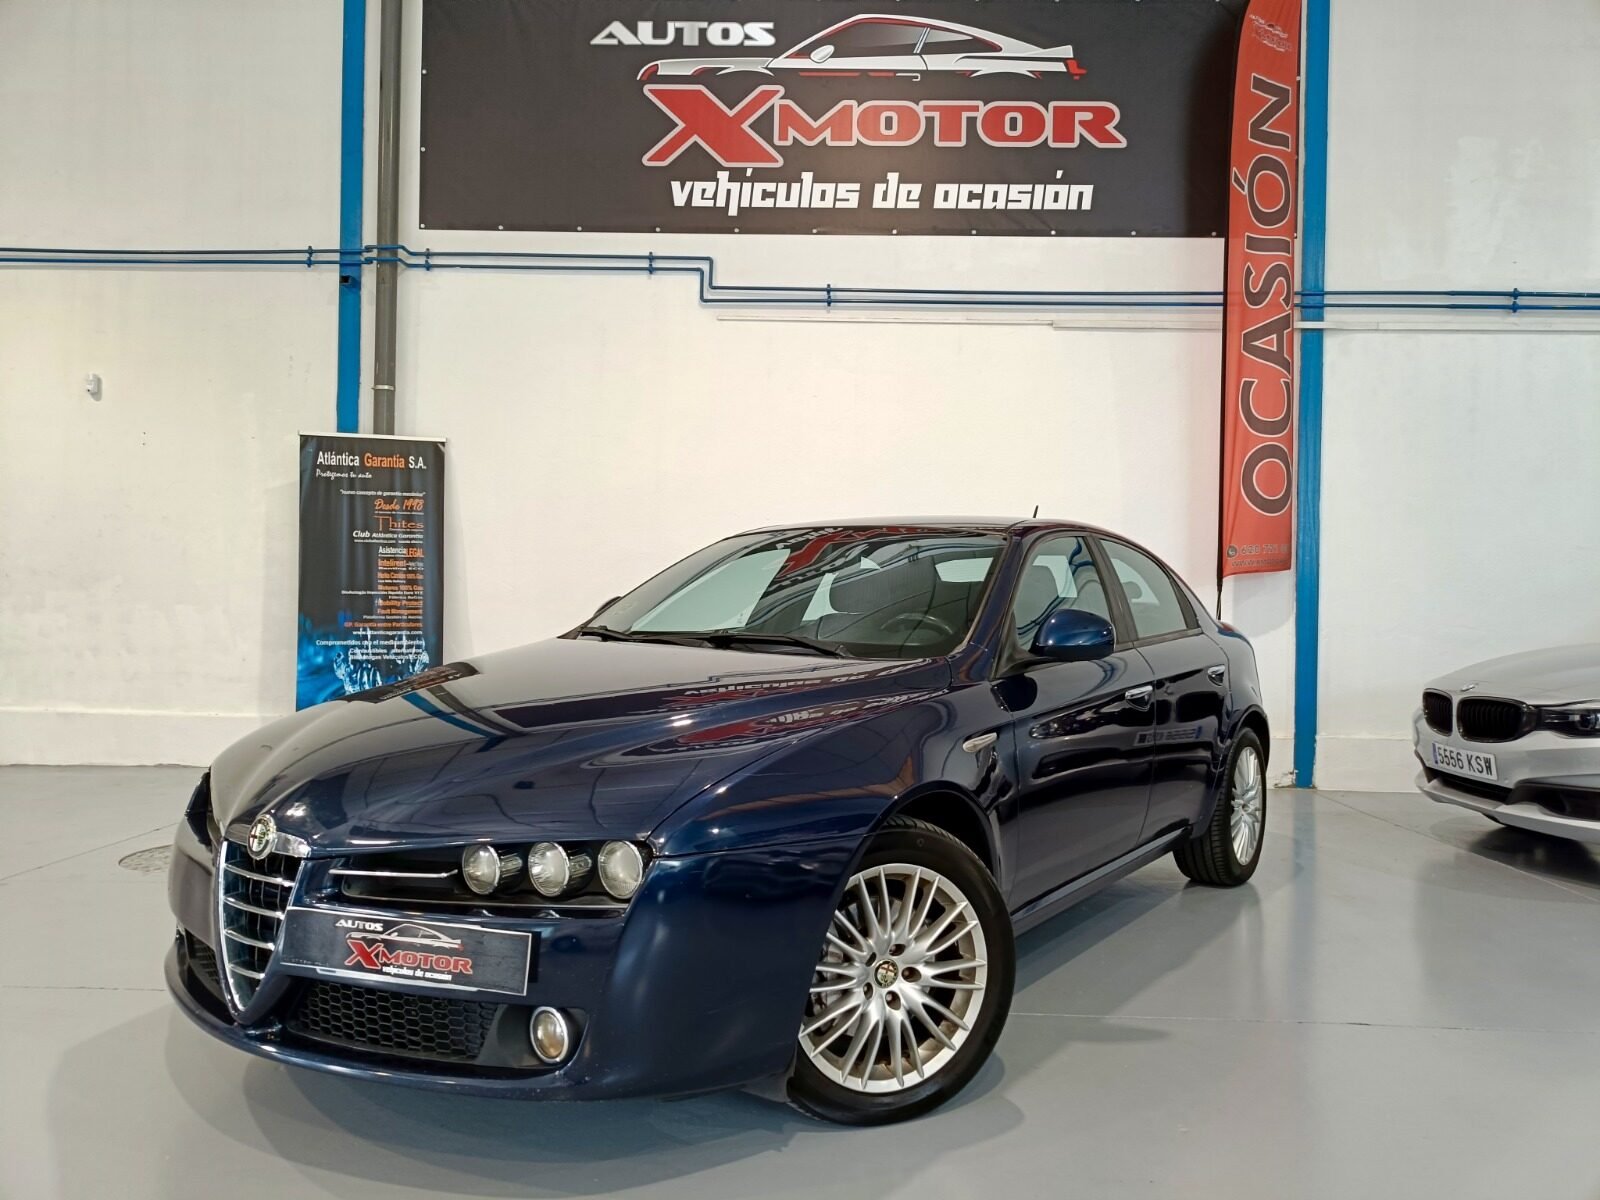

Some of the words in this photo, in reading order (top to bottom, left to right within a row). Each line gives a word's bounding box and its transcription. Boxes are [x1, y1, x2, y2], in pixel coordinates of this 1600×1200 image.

[589, 20, 777, 47] AUTOS
[641, 83, 1128, 168] XMOTOR
[670, 168, 860, 217] vehículos
[872, 171, 922, 209] de
[933, 170, 1095, 211] ocasión
[1231, 72, 1292, 516] OCASIÓN
[316, 450, 360, 466] Atlántica
[408, 455, 427, 470] S.A.
[357, 471, 373, 479] auto
[374, 498, 400, 511] Desde
[403, 498, 425, 511] 1998
[352, 530, 371, 538] Club
[315, 639, 361, 647] Comprometidos
[1437, 746, 1464, 770] 5556
[1466, 754, 1493, 776] KSW
[334, 918, 385, 932] AUTOS
[344, 938, 474, 975] XMOTOR
[414, 967, 425, 978] de
